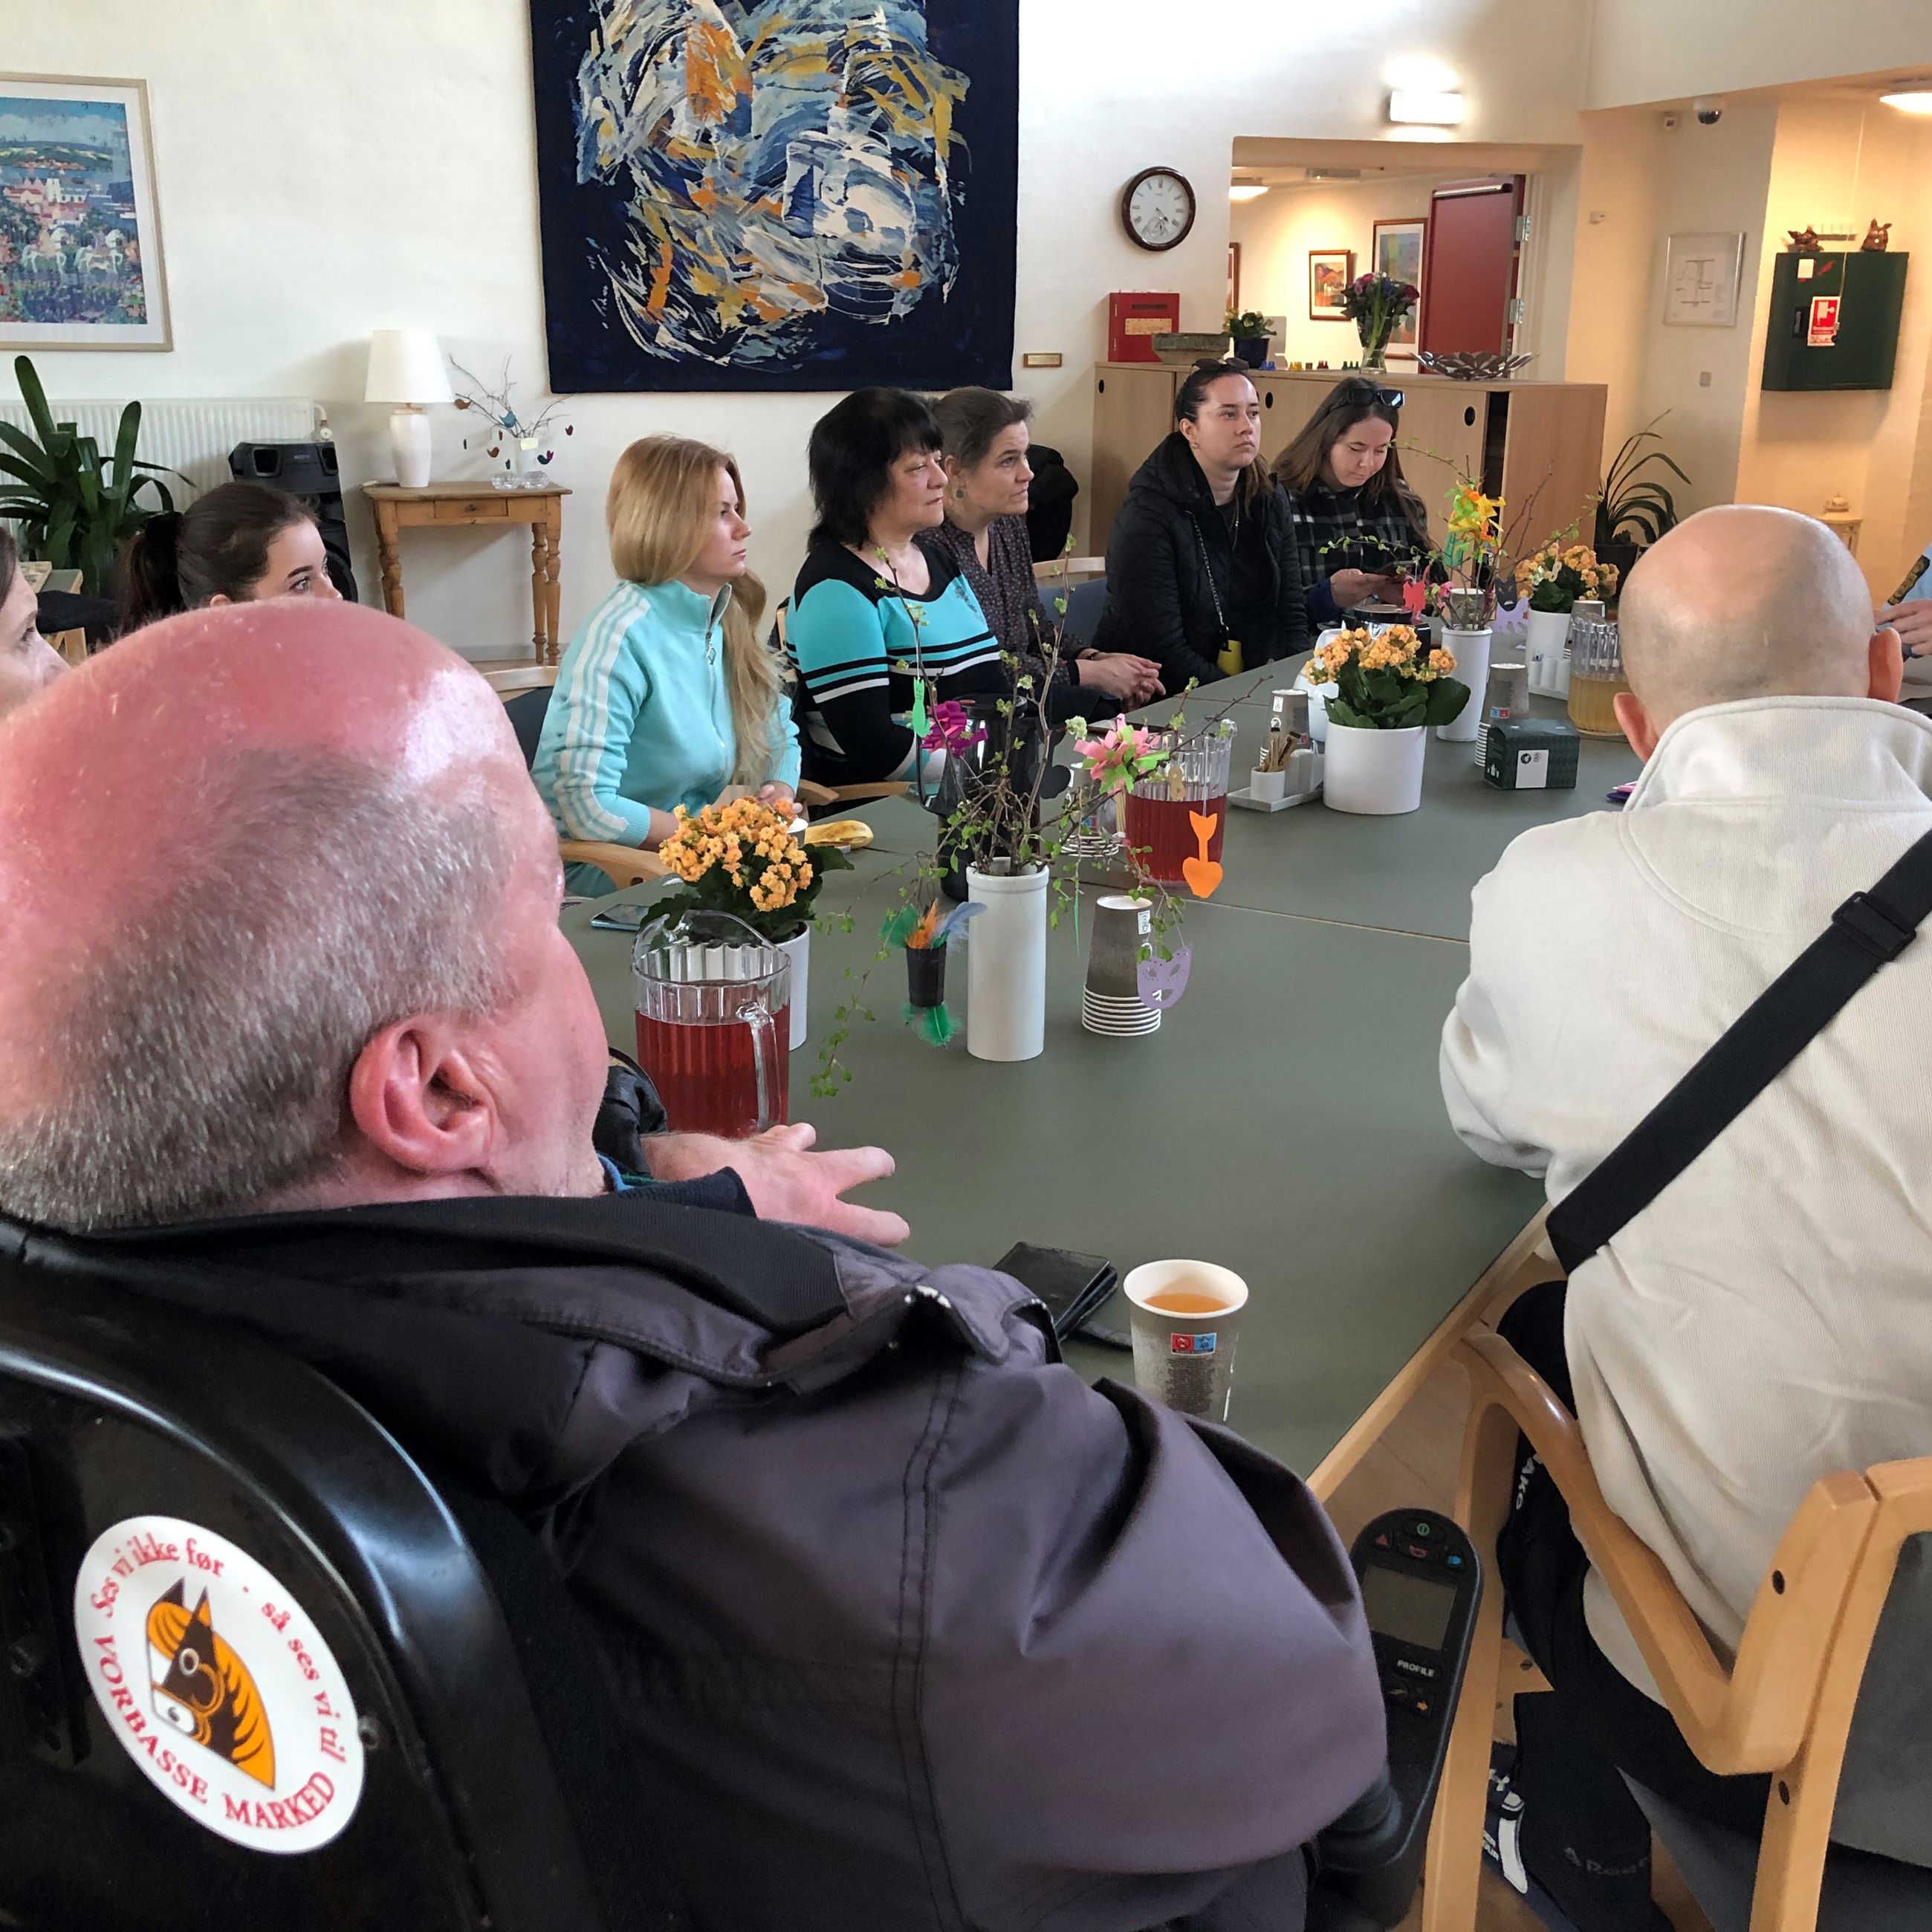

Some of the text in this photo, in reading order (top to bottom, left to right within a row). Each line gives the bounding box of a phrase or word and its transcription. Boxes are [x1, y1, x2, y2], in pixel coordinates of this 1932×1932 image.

[90, 1532, 347, 1763] Ses vi ikke før så ses vi til
[94, 1635, 336, 1830] VORBASSE MARKED
[1397, 1659, 1435, 1677] PROFILE
